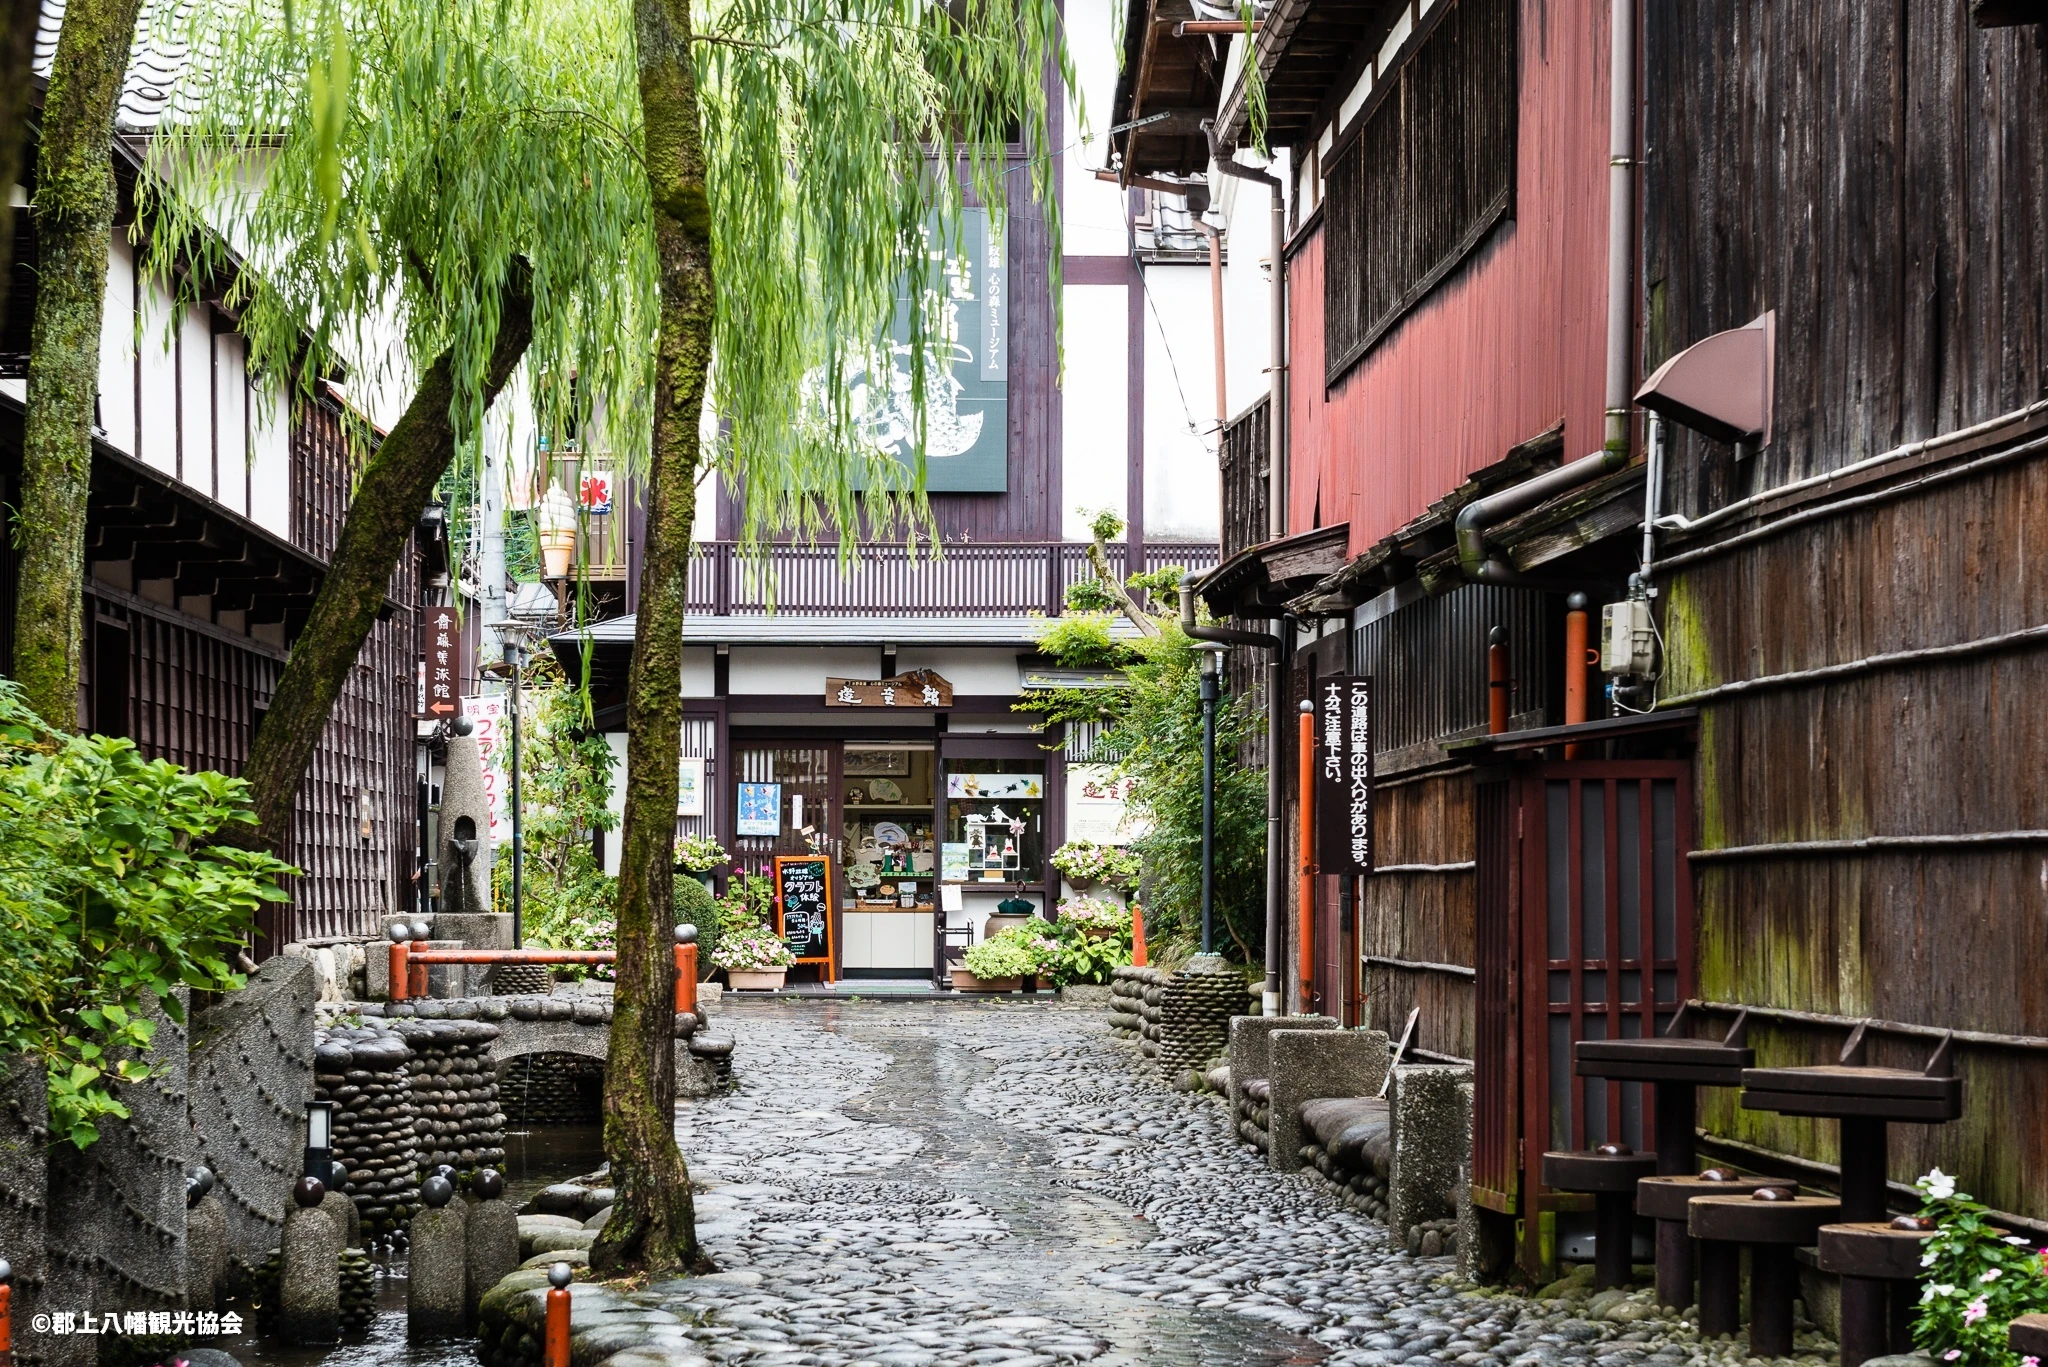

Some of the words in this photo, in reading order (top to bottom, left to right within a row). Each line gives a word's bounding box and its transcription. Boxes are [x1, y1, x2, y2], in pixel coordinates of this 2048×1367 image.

[988, 273, 1001, 370] 心の森ミュージアム
[581, 477, 608, 506] 氷
[837, 684, 940, 706] 遊童館
[1324, 682, 1342, 783] 十分ご注意下さい。
[477, 719, 498, 839] フランクフル
[1350, 681, 1368, 867] この道路は車の出入りがあります。
[784, 880, 824, 893] クラフト
[800, 892, 820, 902] 体験
